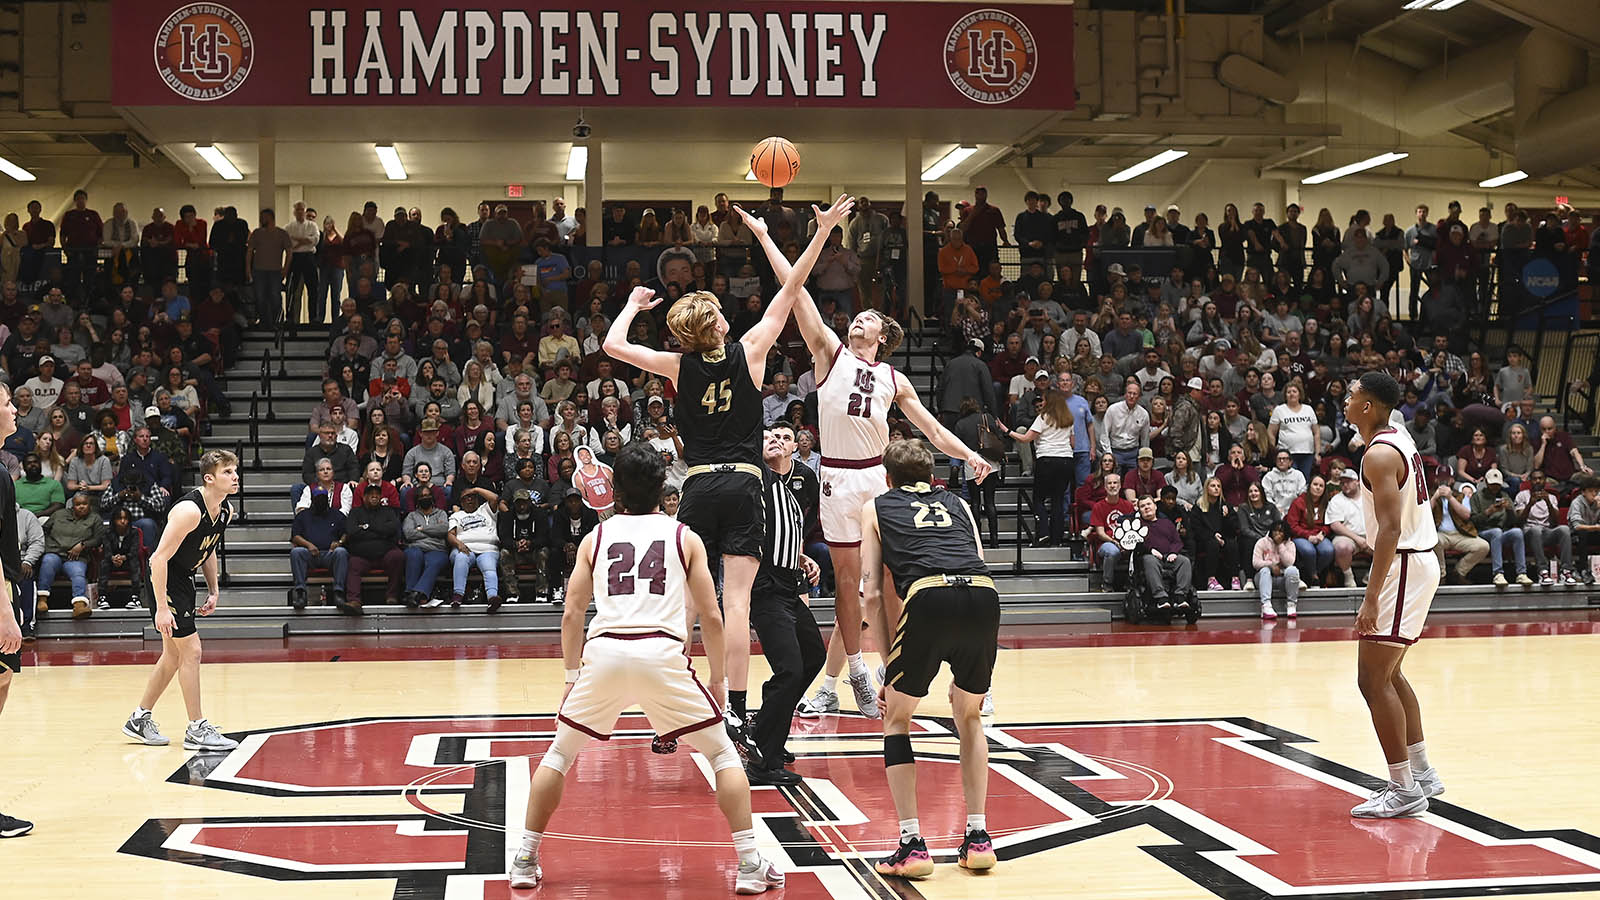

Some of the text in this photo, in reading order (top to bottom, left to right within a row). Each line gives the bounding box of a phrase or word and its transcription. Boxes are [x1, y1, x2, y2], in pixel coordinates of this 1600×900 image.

[158, 5, 250, 48] HAMPDEN-SYDNEY TIGERS
[947, 12, 1034, 54] HAMPDEN-SYDNEY TIGERS
[309, 9, 887, 97] HAMPDEN-SYDNEY
[161, 66, 247, 98] ROUNDBALL CLUB
[951, 71, 1031, 101] ROUNDBALL CLUB
[701, 378, 733, 415] 45
[847, 392, 872, 418] 21
[910, 501, 953, 528] 23
[607, 540, 667, 597] 24
